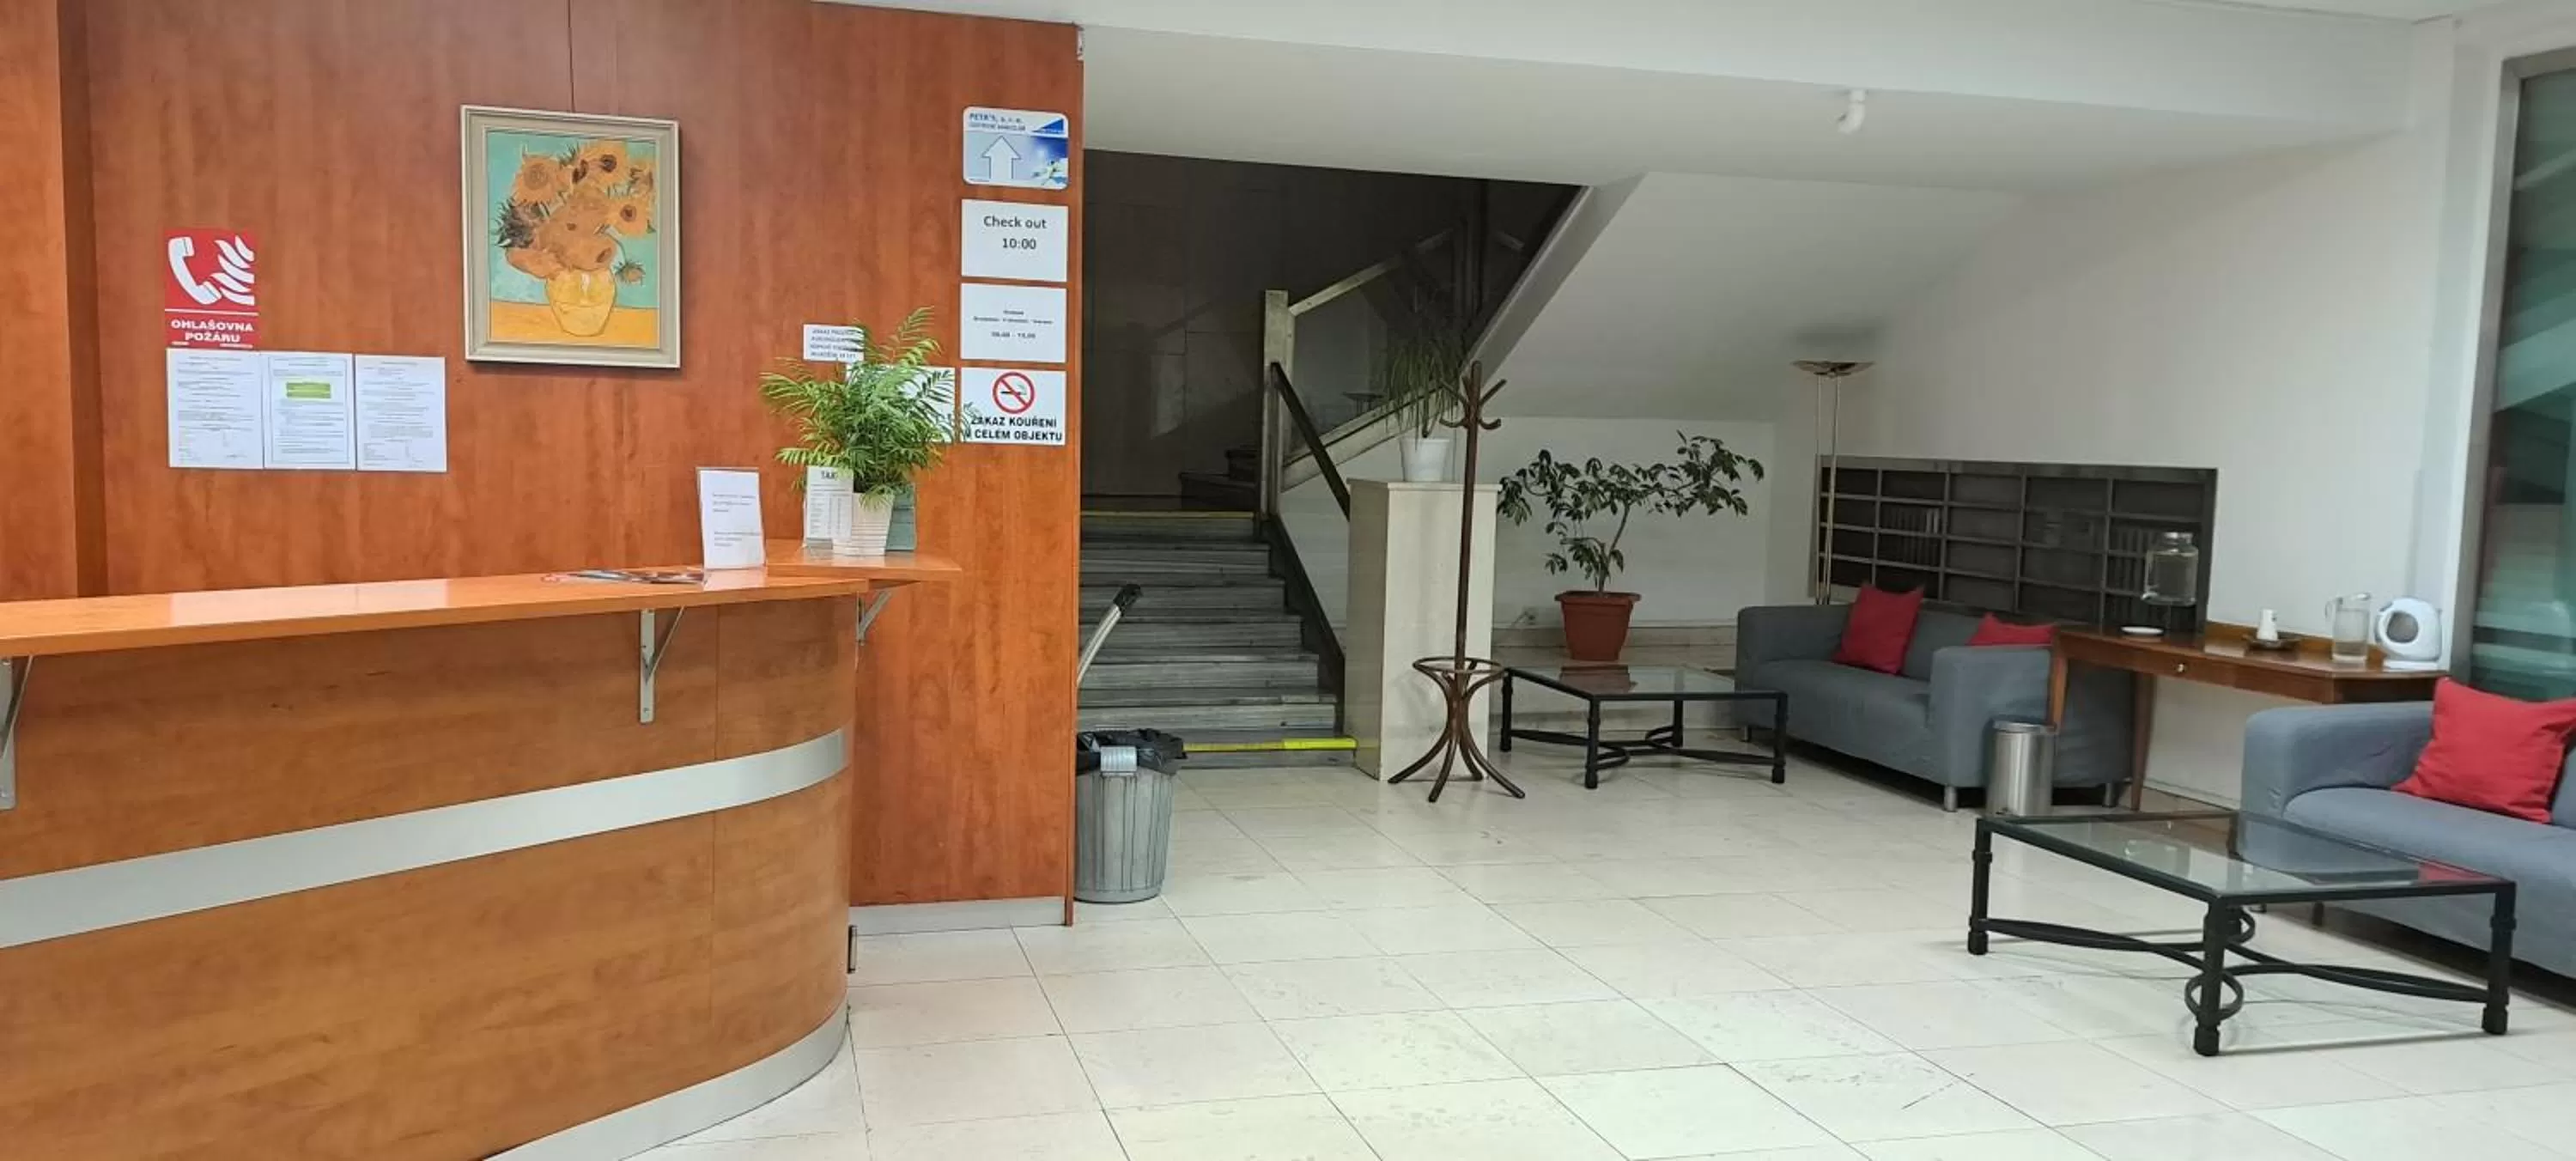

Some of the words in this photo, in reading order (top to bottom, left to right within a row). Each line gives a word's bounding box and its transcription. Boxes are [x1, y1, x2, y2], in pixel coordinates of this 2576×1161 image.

[983, 215, 1022, 228] Check
[1024, 219, 1047, 229] out
[1002, 238, 1036, 250] 10:00
[171, 319, 254, 331] OHLAŠOVNA
[185, 331, 240, 343] POŽÁRU
[1009, 416, 1057, 428] KOUŘENÍ
[1014, 430, 1062, 441] OBJEKTU
